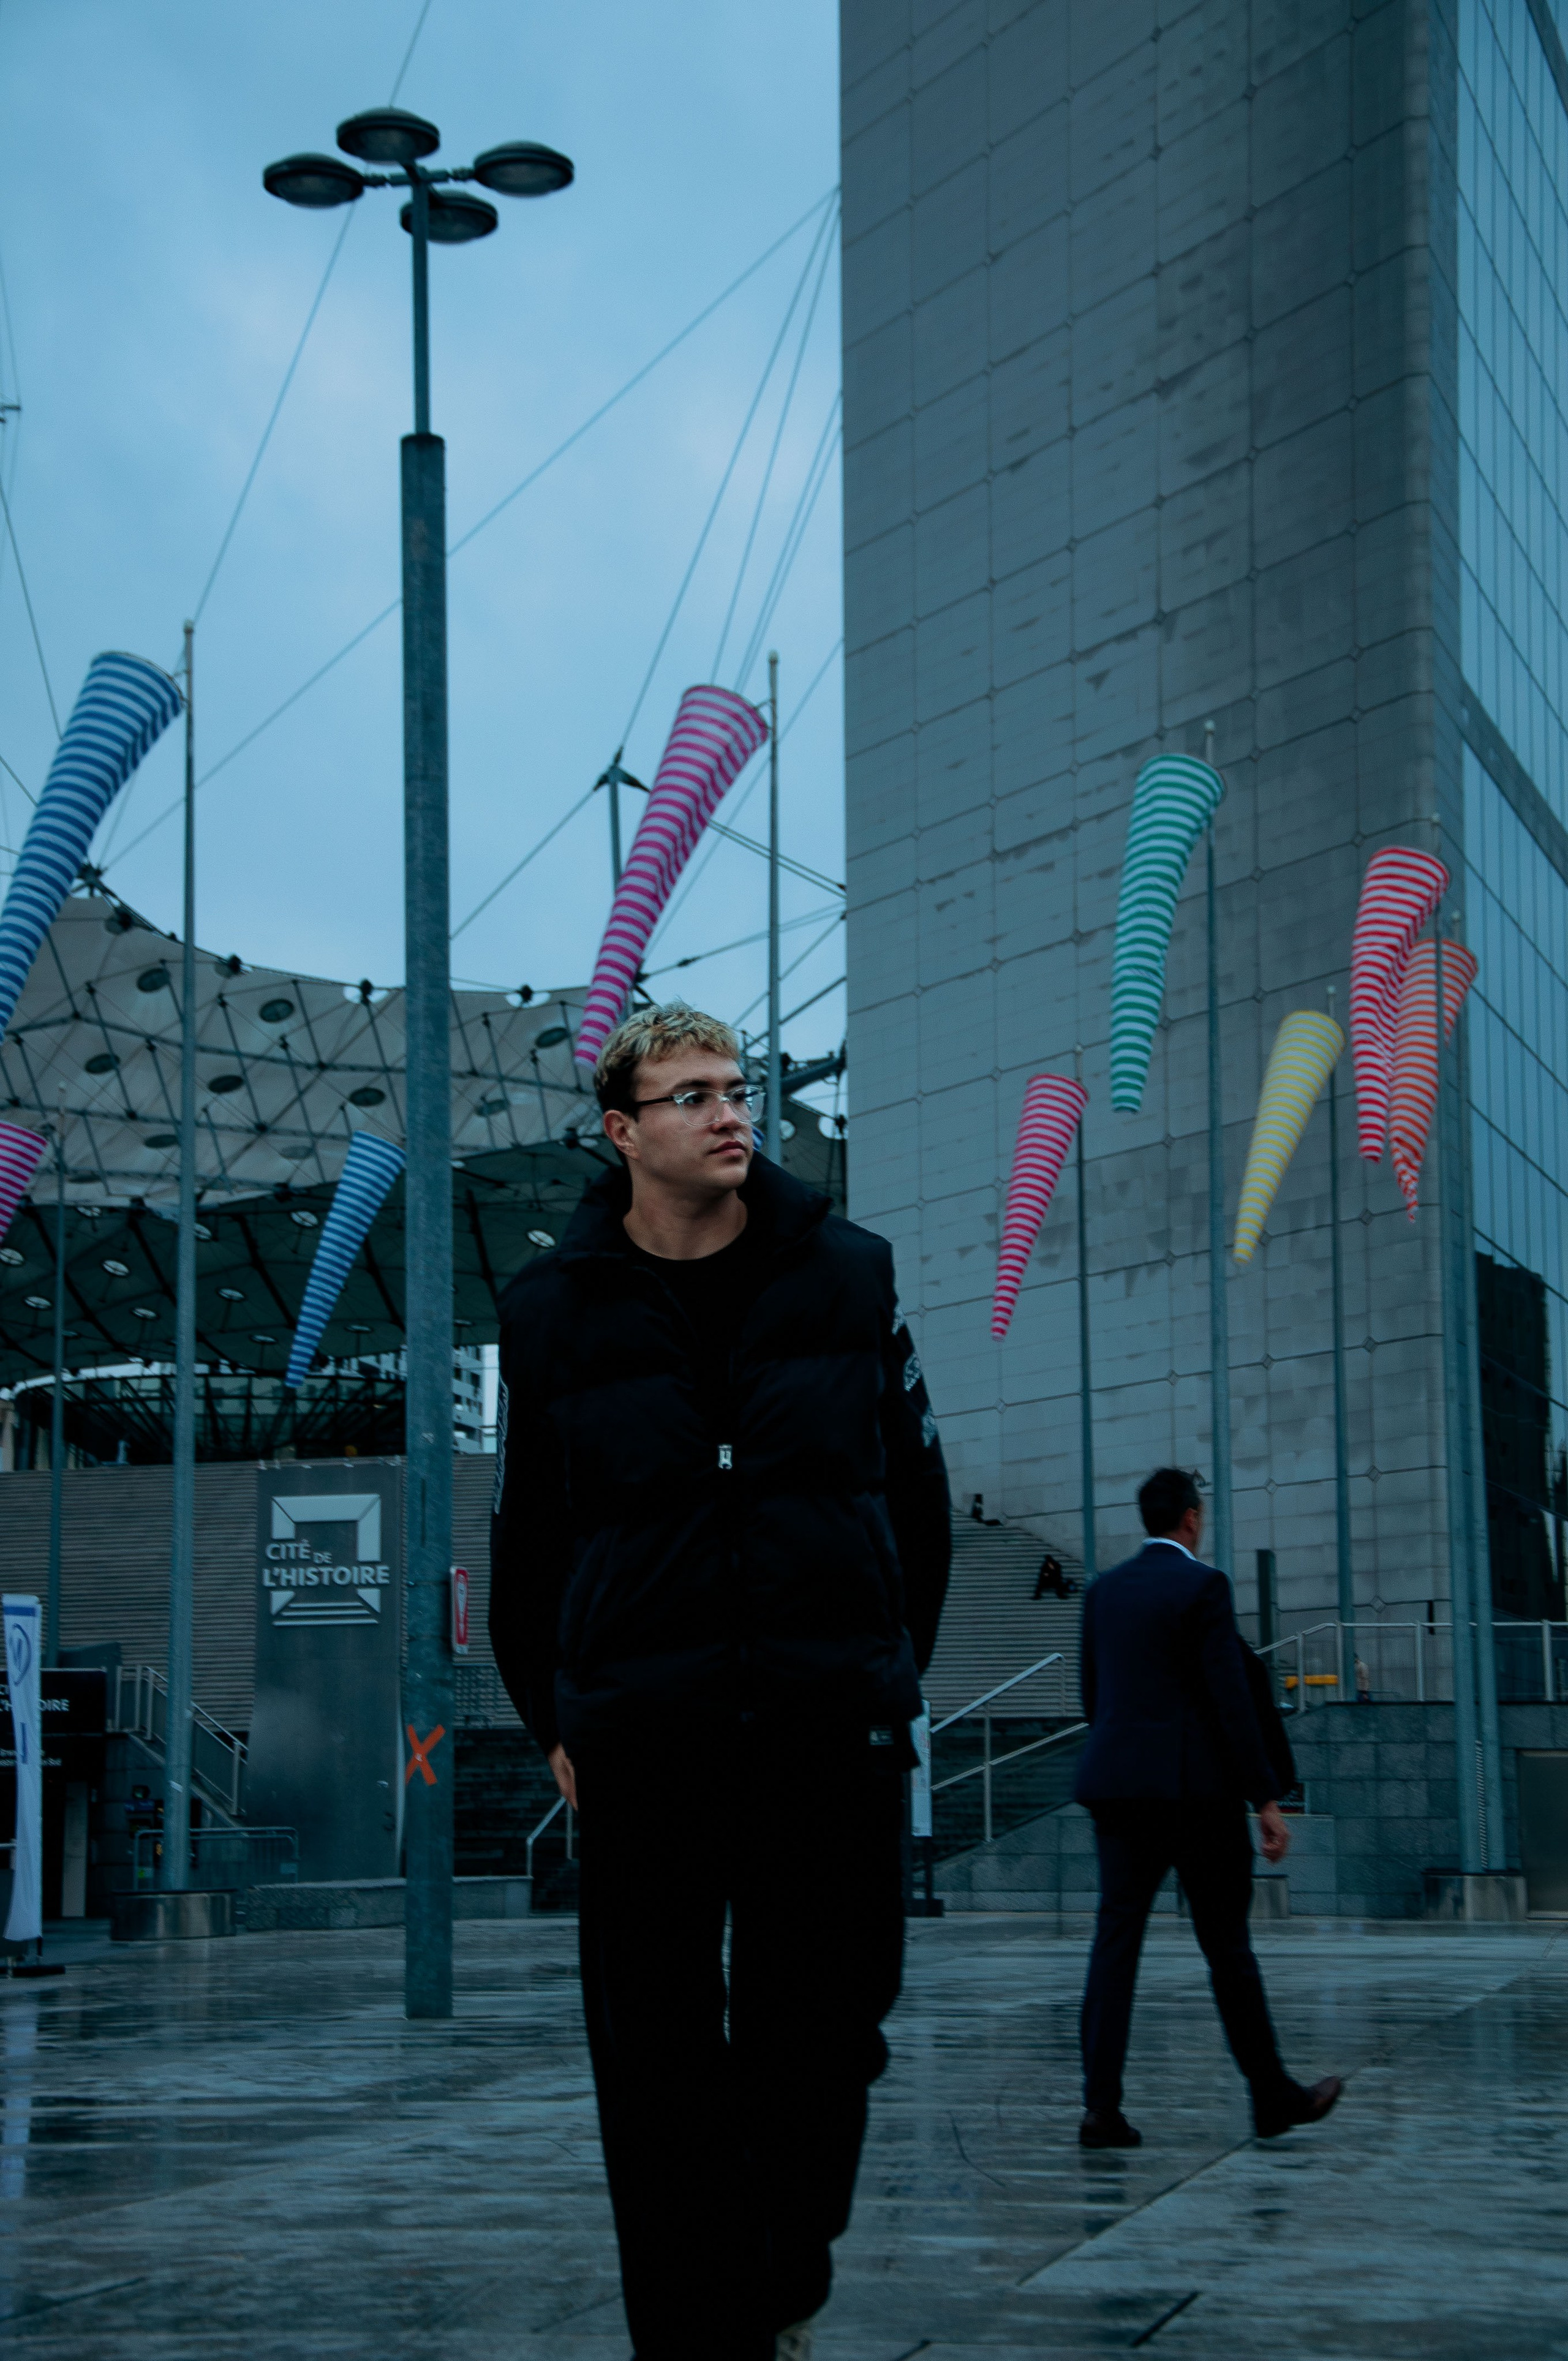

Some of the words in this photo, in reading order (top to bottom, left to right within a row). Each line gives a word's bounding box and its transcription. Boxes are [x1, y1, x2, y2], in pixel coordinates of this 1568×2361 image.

[265, 1539, 311, 1561] CITÉ
[313, 1551, 333, 1564] DE
[262, 1565, 390, 1587] L'HISTOIRE
